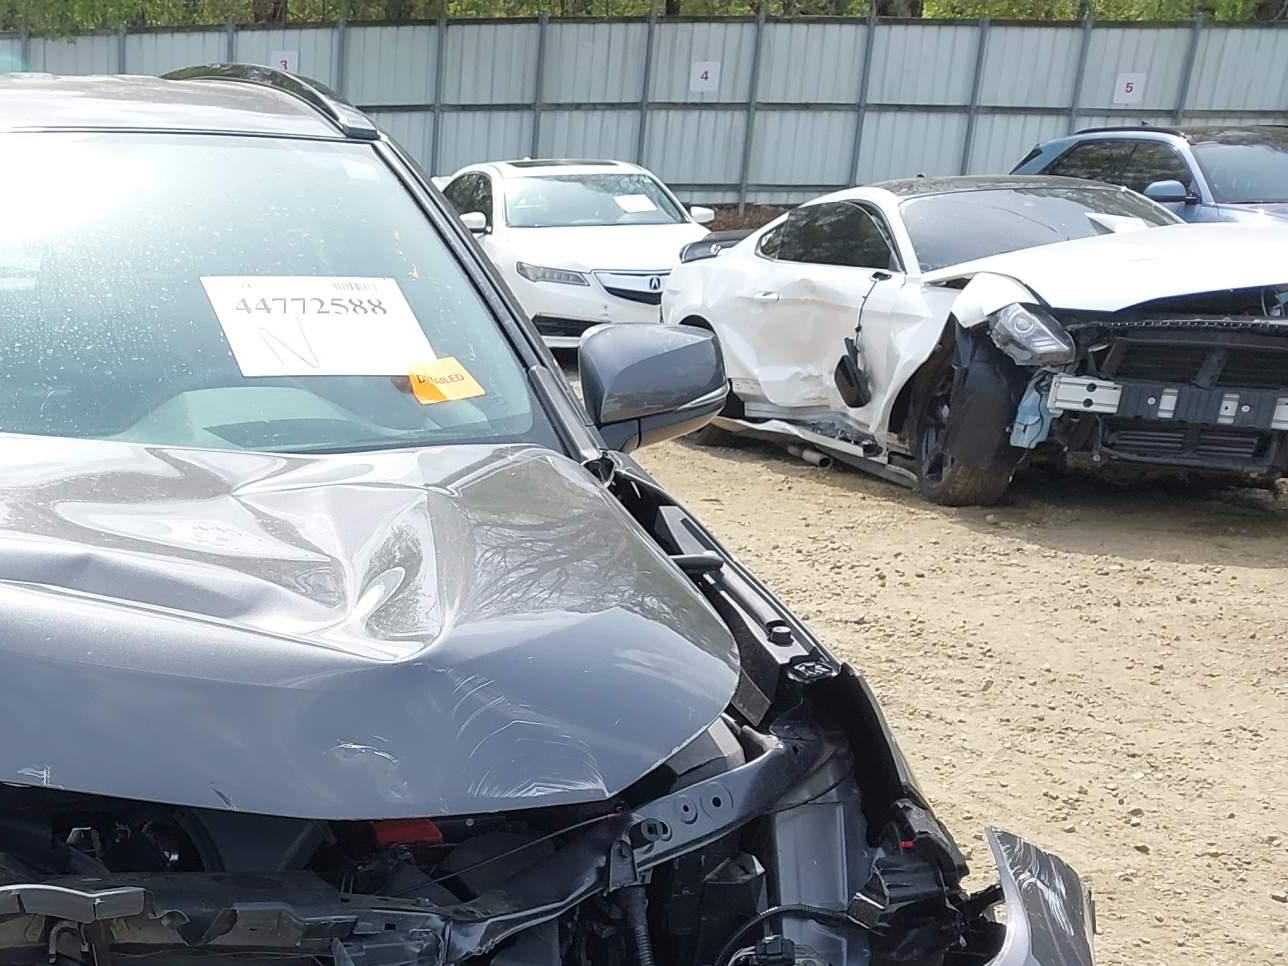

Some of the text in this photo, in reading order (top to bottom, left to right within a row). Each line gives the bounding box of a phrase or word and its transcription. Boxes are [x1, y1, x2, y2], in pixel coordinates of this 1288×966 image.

[700, 70, 710, 81] 4
[1124, 82, 1135, 93] 5
[235, 297, 388, 315] 44772588
